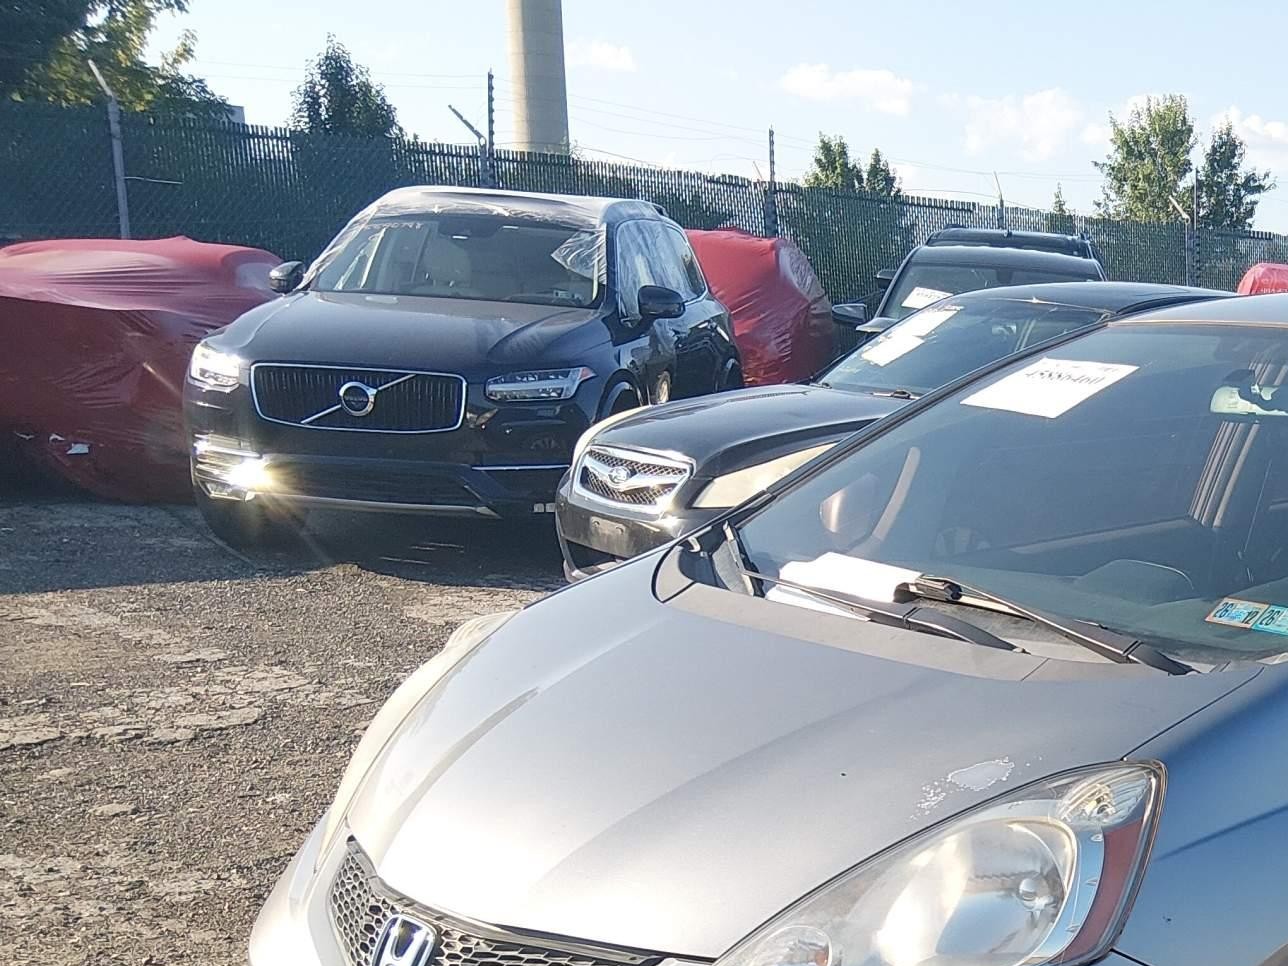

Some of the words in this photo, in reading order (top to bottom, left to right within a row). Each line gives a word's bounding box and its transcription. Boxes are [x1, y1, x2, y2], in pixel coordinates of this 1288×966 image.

[1213, 602, 1234, 618] 26
[1241, 610, 1260, 625] 12
[1259, 609, 1281, 626] 26
